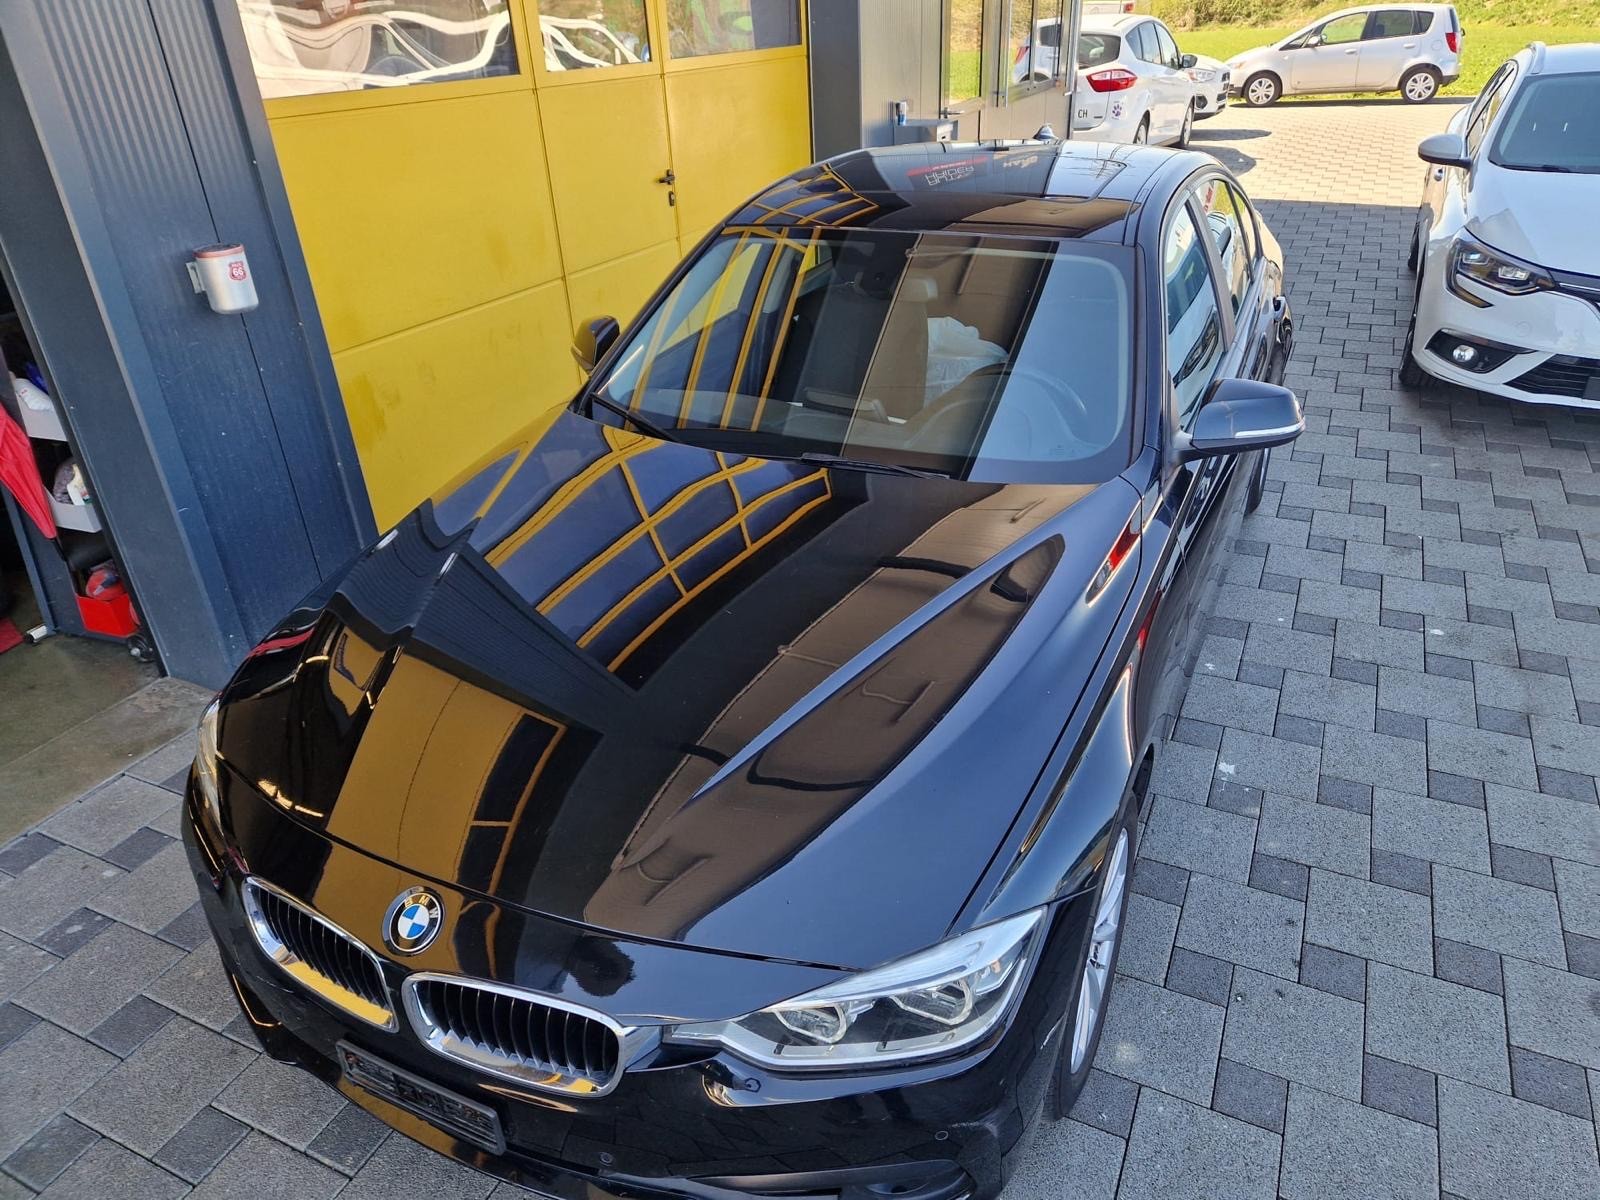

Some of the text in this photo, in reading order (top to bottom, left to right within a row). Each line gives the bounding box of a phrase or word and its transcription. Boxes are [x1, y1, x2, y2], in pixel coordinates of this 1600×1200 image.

[1077, 109, 1088, 118] CH
[232, 267, 244, 276] 66
[404, 895, 439, 919] BMW
